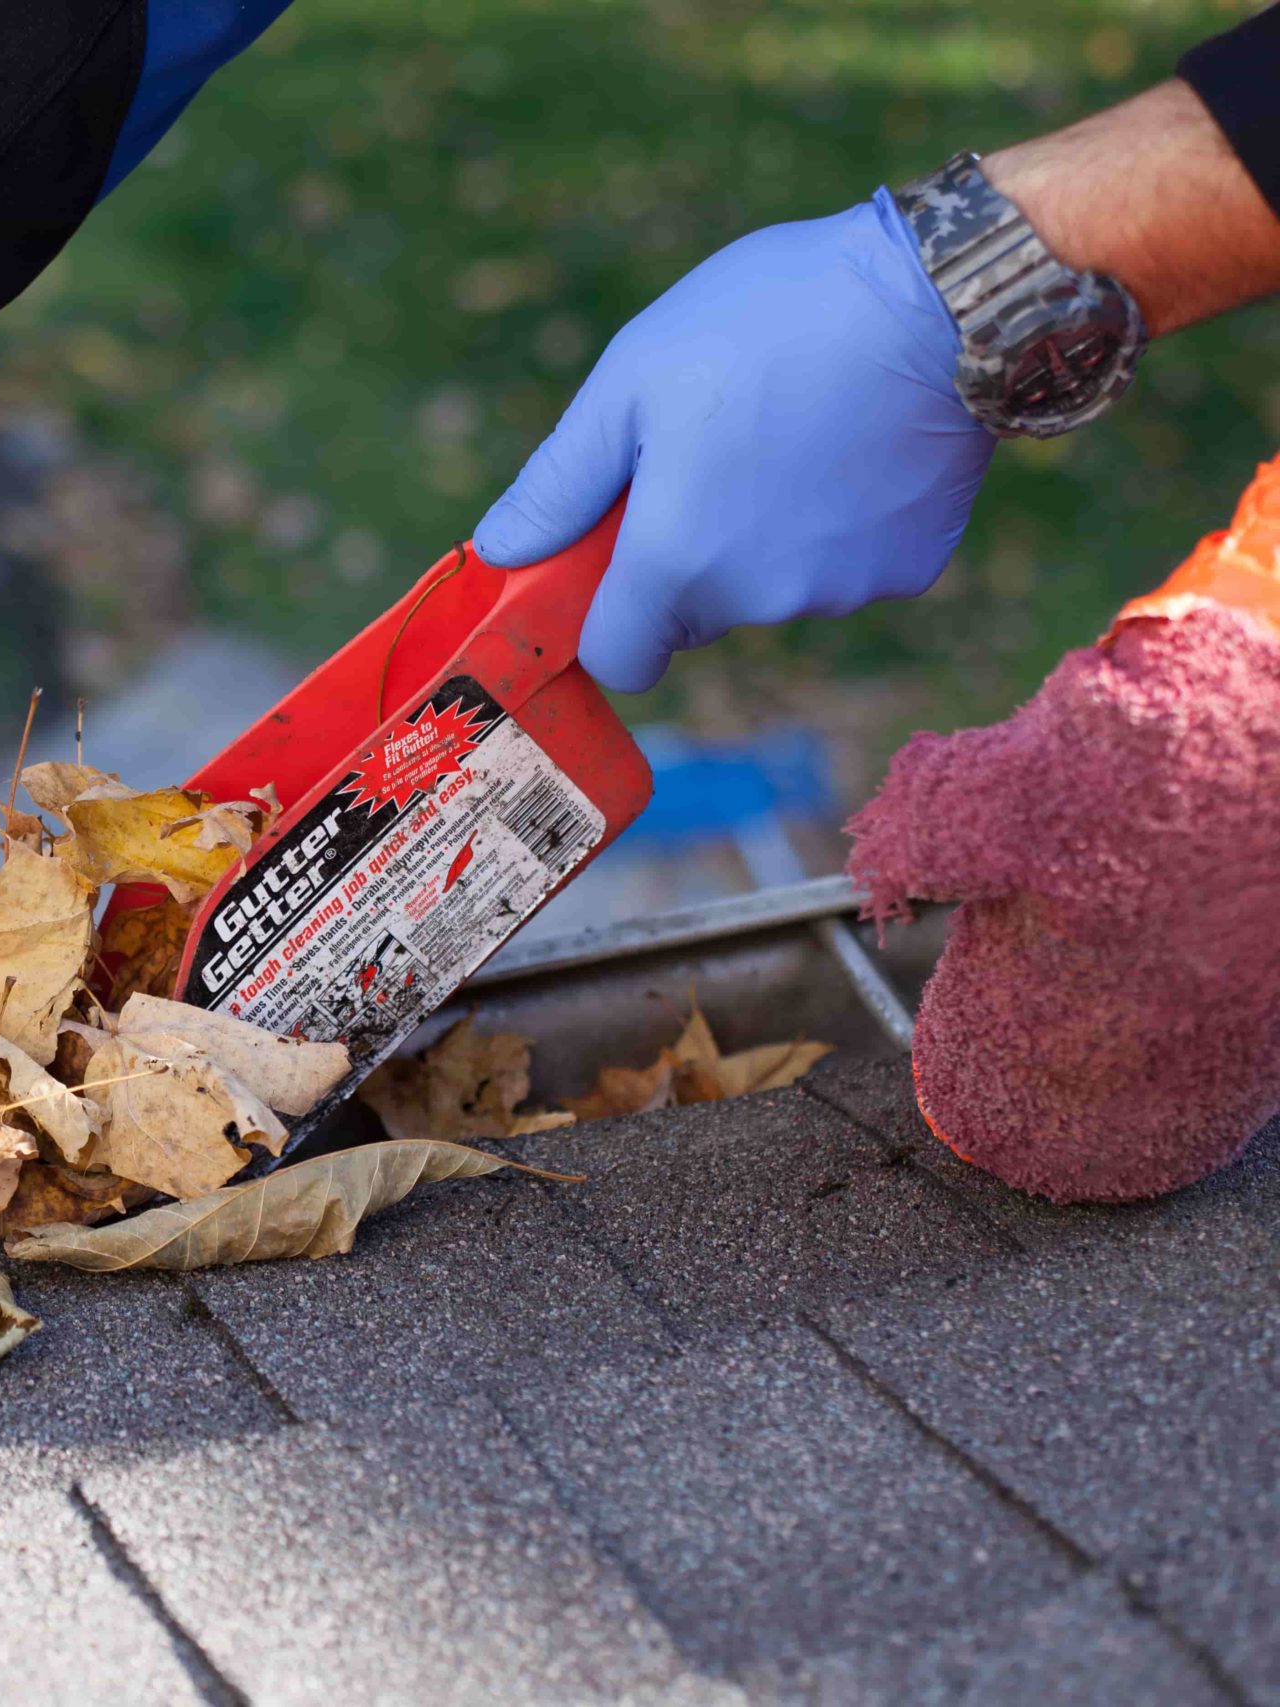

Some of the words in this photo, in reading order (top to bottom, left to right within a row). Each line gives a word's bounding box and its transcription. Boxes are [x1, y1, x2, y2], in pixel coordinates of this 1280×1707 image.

[383, 729, 420, 756] Flexes
[418, 721, 433, 734] to
[383, 750, 401, 768] Fit
[400, 726, 439, 757] Gutter!
[212, 805, 341, 944] Gutter
[227, 1000, 241, 1017] a
[239, 955, 281, 1003] tough
[281, 896, 344, 962] cleaning
[340, 867, 370, 902] job
[367, 828, 408, 876] quick
[408, 800, 438, 835] and
[437, 763, 477, 805] easy.
[262, 976, 289, 1001] Time
[290, 943, 320, 973] Saves
[317, 915, 348, 946] Hands
[351, 876, 387, 912] Durable
[384, 817, 447, 878] Polypropylene
[328, 932, 350, 954] Ahorra
[347, 912, 370, 934] tiempo
[372, 884, 397, 909] Protege
[394, 874, 407, 886] las
[406, 853, 427, 875] manos
[340, 932, 362, 957] gagner
[360, 923, 371, 935] du
[368, 905, 389, 926] temps
[392, 879, 416, 903] Protège
[414, 868, 426, 880] les
[425, 850, 444, 870] mains
[278, 996, 298, 1021] travail
